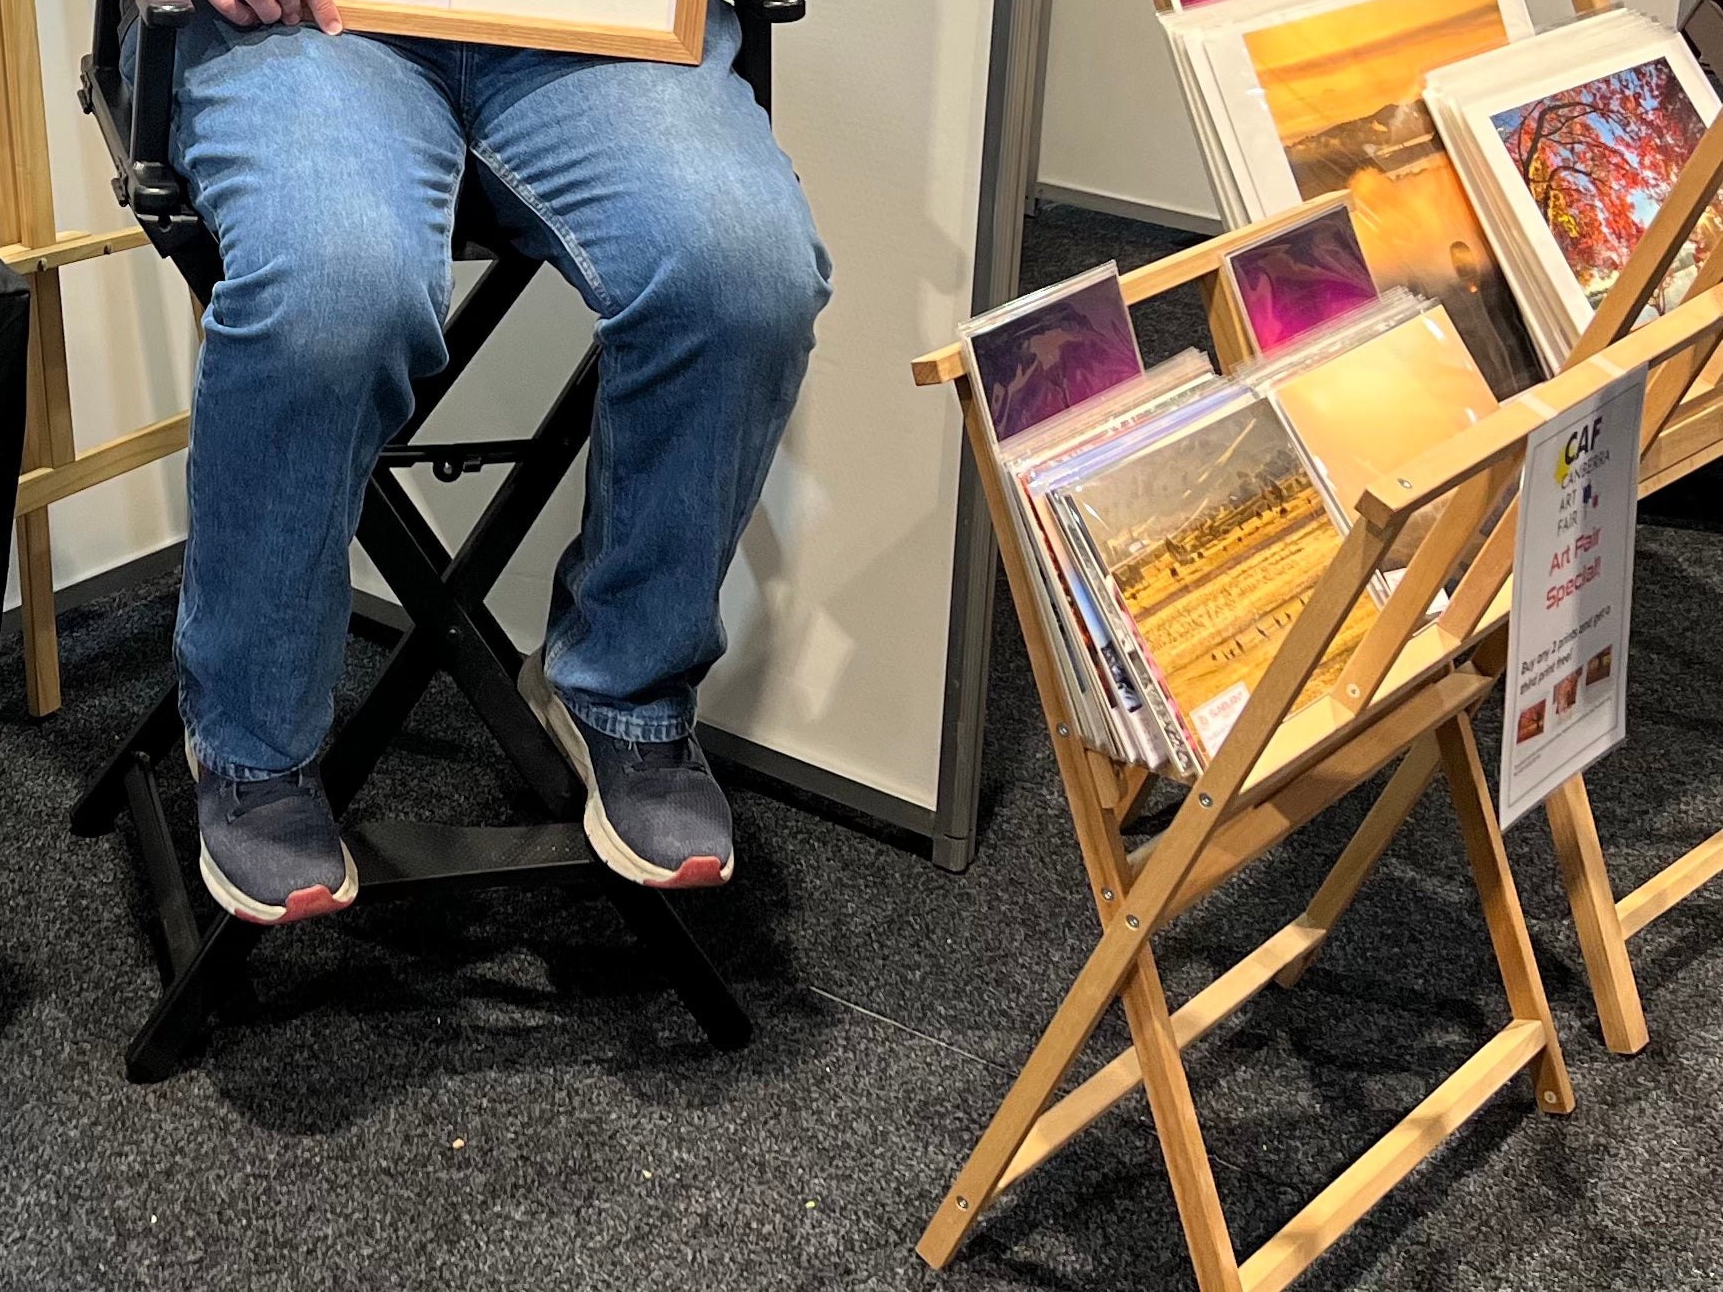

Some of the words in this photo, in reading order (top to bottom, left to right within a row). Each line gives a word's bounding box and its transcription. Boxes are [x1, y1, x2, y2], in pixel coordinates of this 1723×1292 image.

[1564, 416, 1603, 466] CAF
[1561, 449, 1610, 489] CANBERRA
[1559, 490, 1577, 511] ART
[1557, 511, 1578, 536] FAIR
[1549, 545, 1571, 576] Art
[1575, 527, 1601, 558] Fair
[1546, 556, 1601, 609] Special!
[1521, 659, 1535, 676] Buy
[1536, 648, 1550, 665] any
